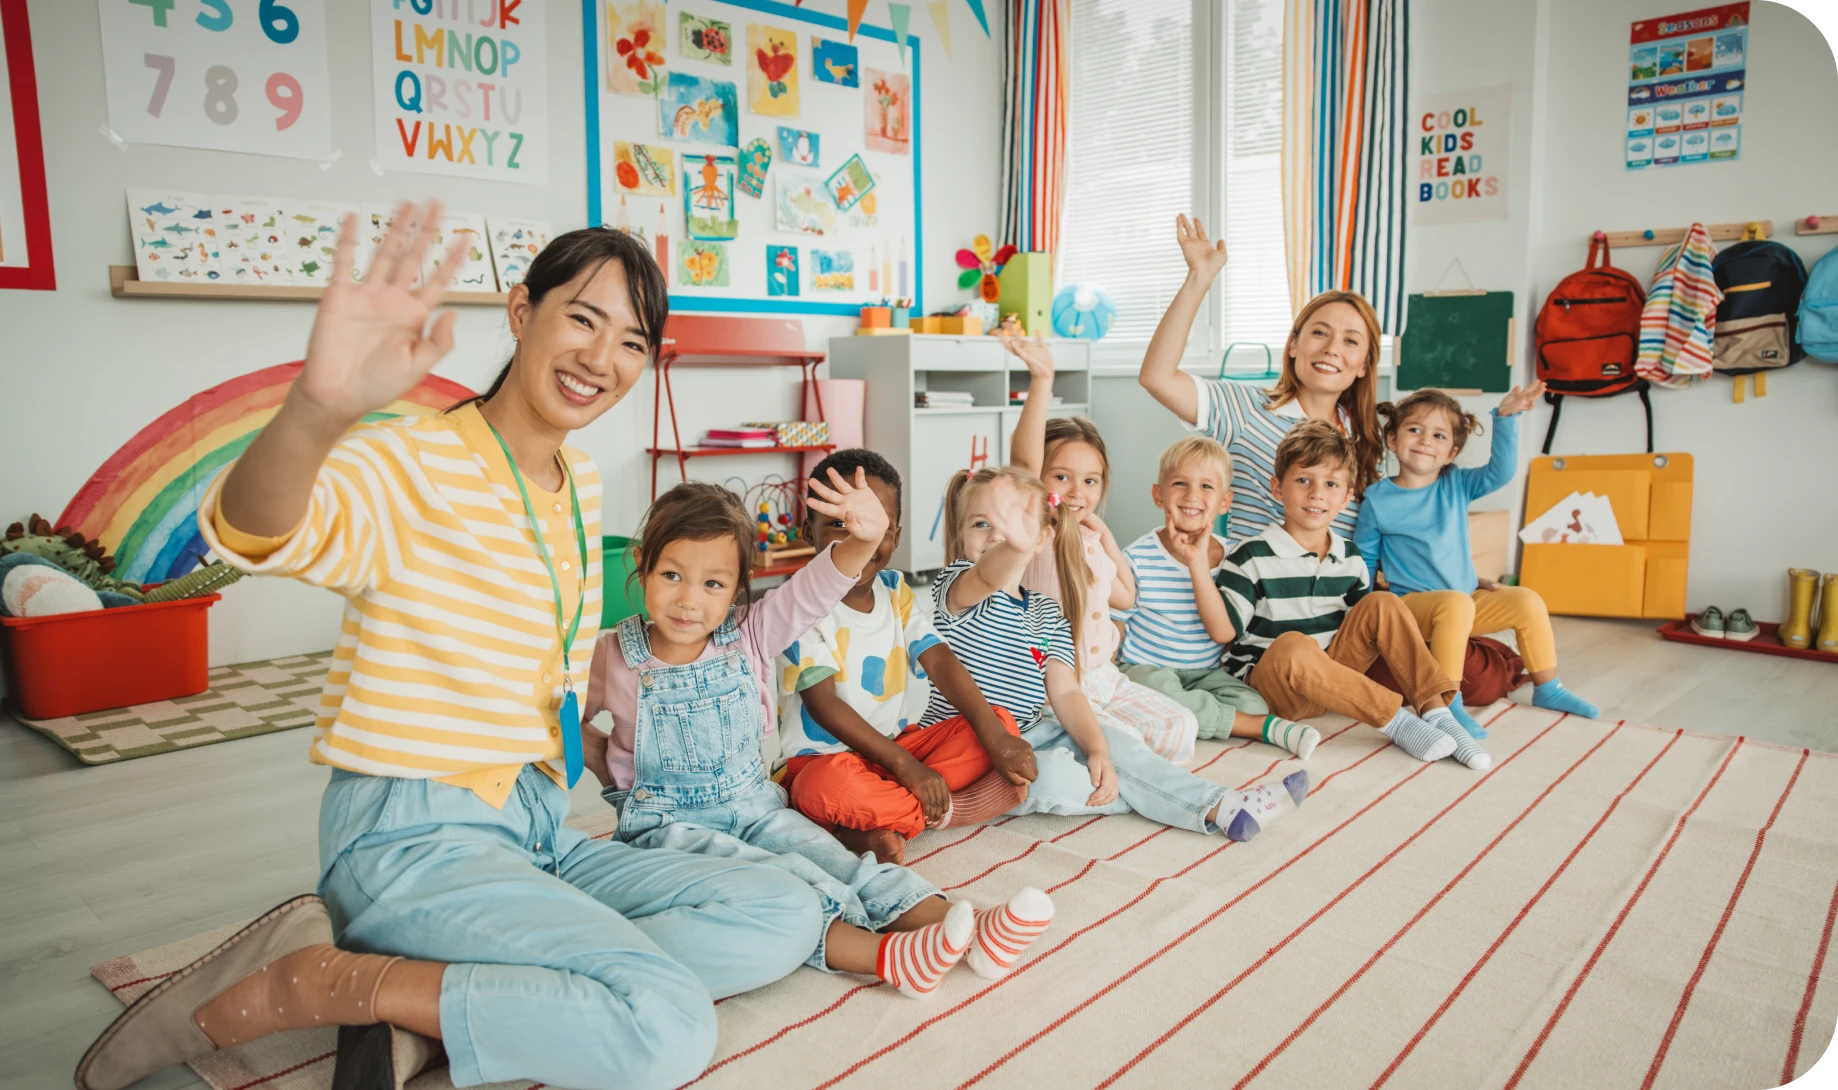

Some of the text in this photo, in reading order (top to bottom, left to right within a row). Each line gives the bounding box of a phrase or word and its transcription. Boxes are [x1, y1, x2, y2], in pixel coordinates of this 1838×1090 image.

[259, 0, 300, 45] 6
[1658, 15, 1719, 35] Seasons
[394, 19, 521, 78] LMNOP
[143, 52, 304, 132] 7 8 9
[395, 70, 522, 126] QRSTU
[1655, 79, 1716, 98] Weather
[1421, 106, 1484, 132] COOL
[396, 117, 524, 169] VWXYZ
[1421, 131, 1475, 156] KIDS
[1420, 154, 1483, 179] READ
[1419, 176, 1499, 202] BOOKS
